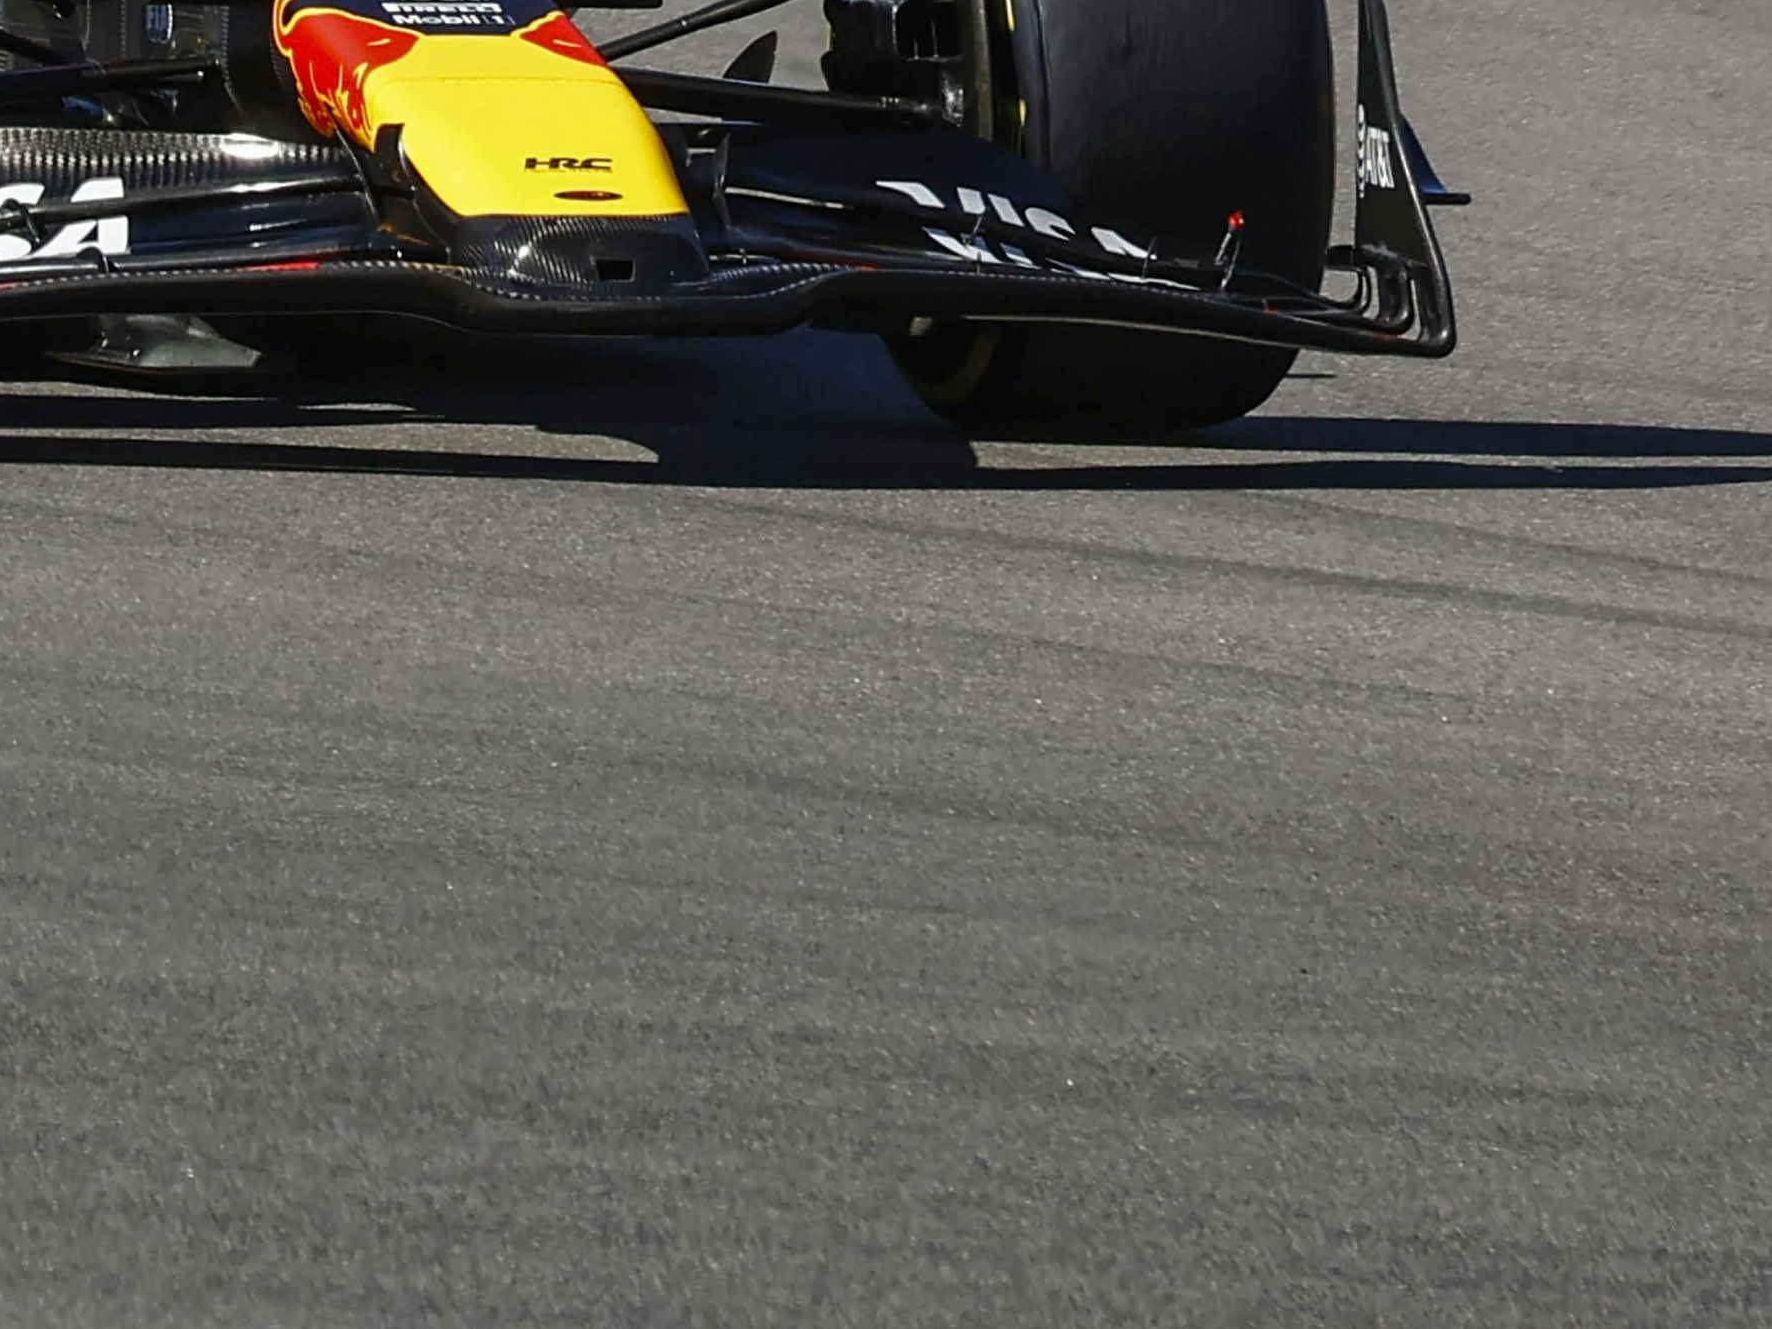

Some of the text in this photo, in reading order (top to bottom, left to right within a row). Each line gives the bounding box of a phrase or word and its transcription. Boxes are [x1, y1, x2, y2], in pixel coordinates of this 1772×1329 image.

[392, 14, 481, 25] Mobil
[524, 157, 613, 170] HRC
[1366, 126, 1395, 189] AT&T
